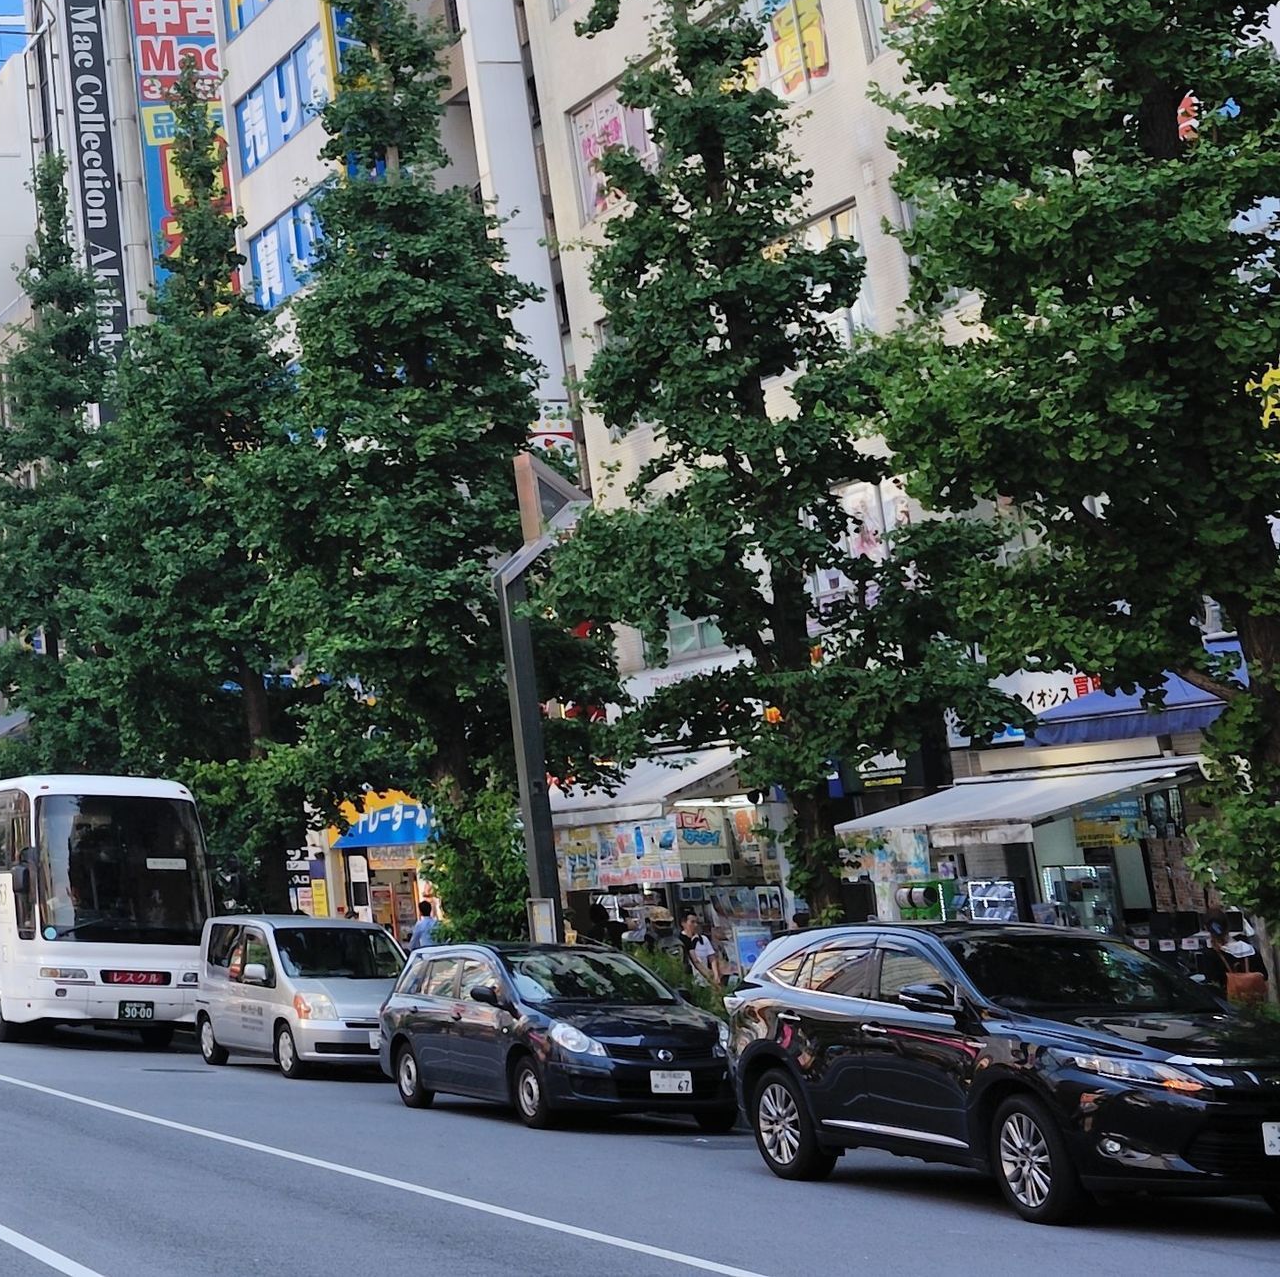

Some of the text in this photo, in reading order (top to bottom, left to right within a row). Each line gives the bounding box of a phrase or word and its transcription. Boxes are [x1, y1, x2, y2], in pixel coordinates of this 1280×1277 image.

[68, 5, 99, 69] Mac
[74, 74, 112, 229] Collection
[1026, 686, 1073, 709] イオシス
[113, 972, 160, 984] レスクル
[124, 1006, 153, 1020] 90-00
[677, 1079, 691, 1092] 67
